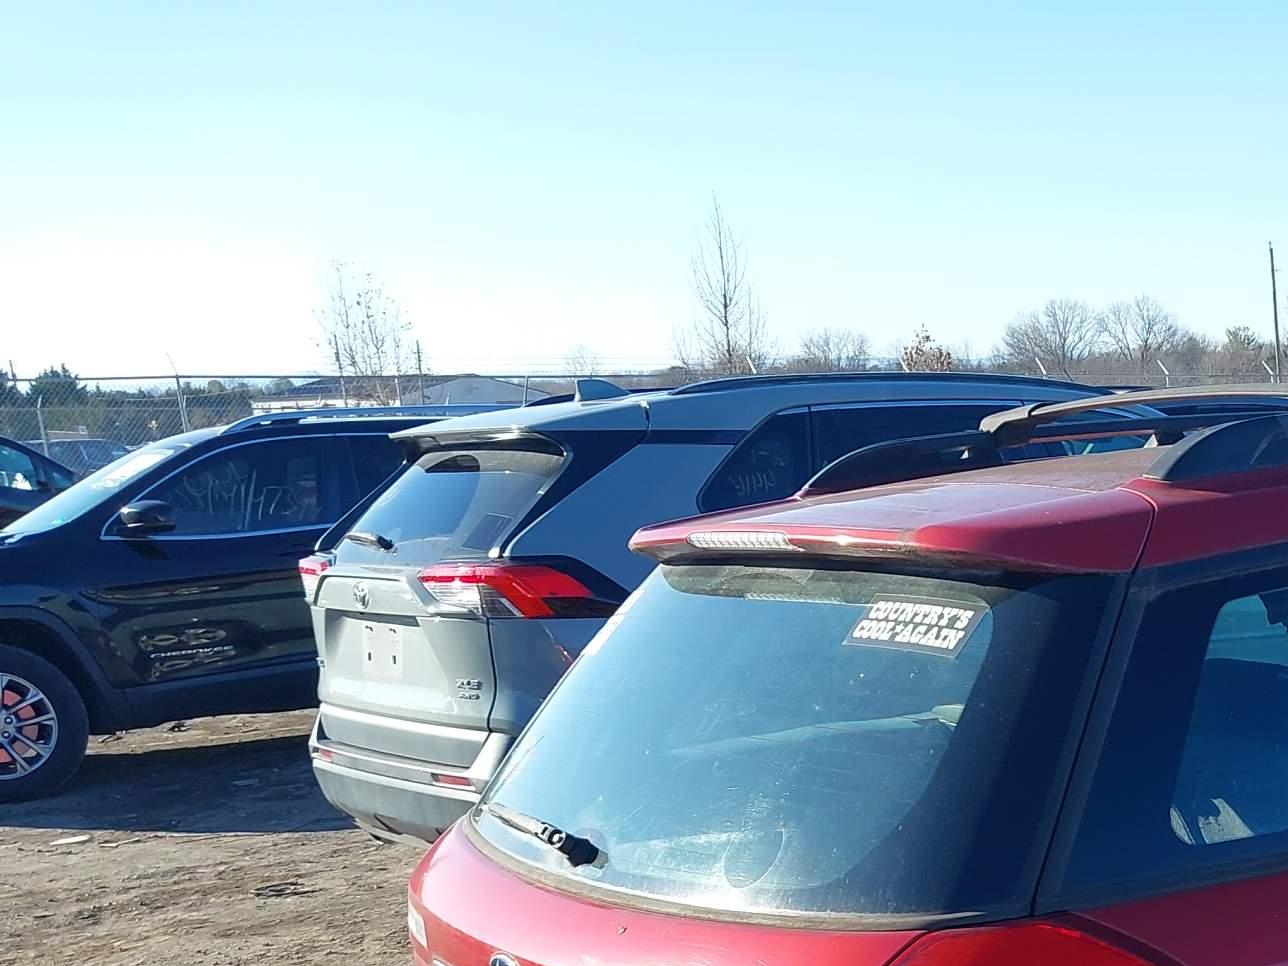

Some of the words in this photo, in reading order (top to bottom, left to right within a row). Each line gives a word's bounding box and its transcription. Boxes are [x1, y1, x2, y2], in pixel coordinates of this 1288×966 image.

[869, 600, 975, 628] COUNTRY'S
[852, 619, 895, 641] COOL
[895, 623, 966, 650] AGAIN
